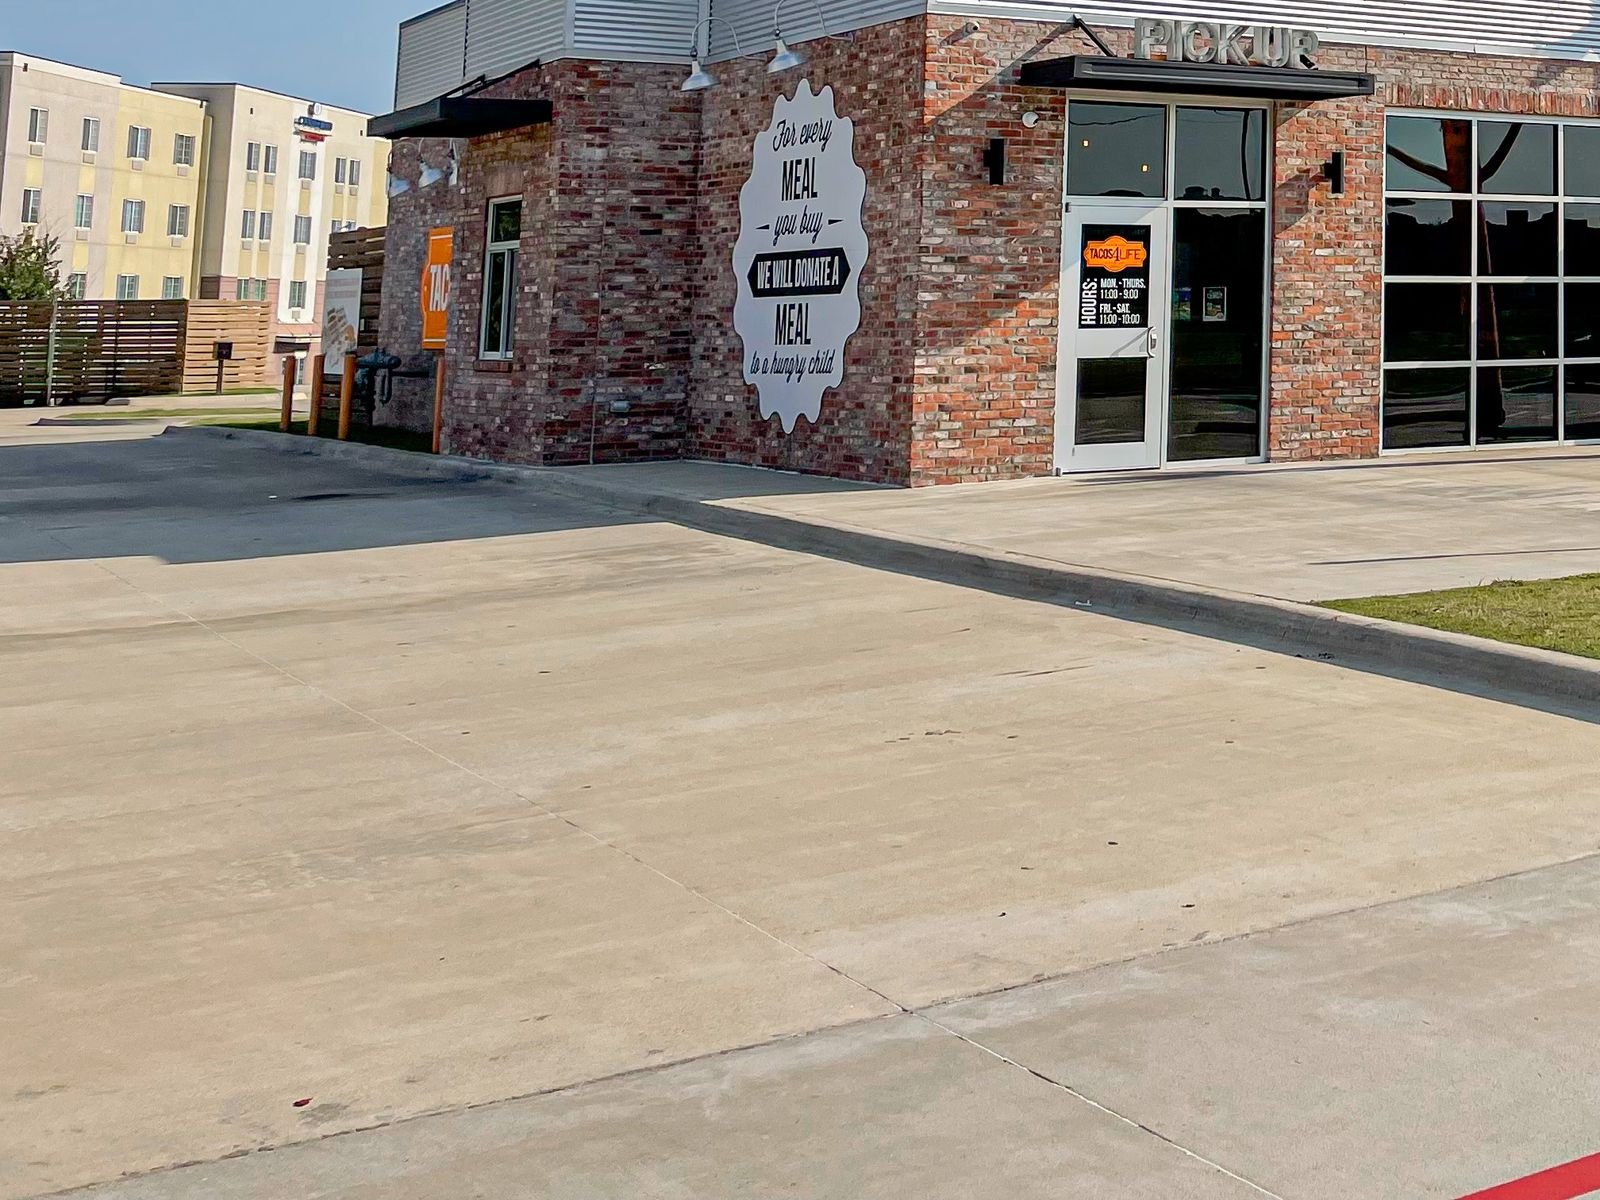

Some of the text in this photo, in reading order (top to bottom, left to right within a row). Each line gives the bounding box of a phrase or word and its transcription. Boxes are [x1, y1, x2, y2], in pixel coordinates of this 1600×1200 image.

[773, 117, 832, 152] For every
[781, 157, 818, 201] MEAL
[773, 204, 823, 246] you buy
[757, 256, 839, 290] WE WILL DONATE A
[1081, 278, 1098, 325] HOURS:
[774, 303, 811, 346] MEAL
[750, 350, 834, 383] to a hungry child
